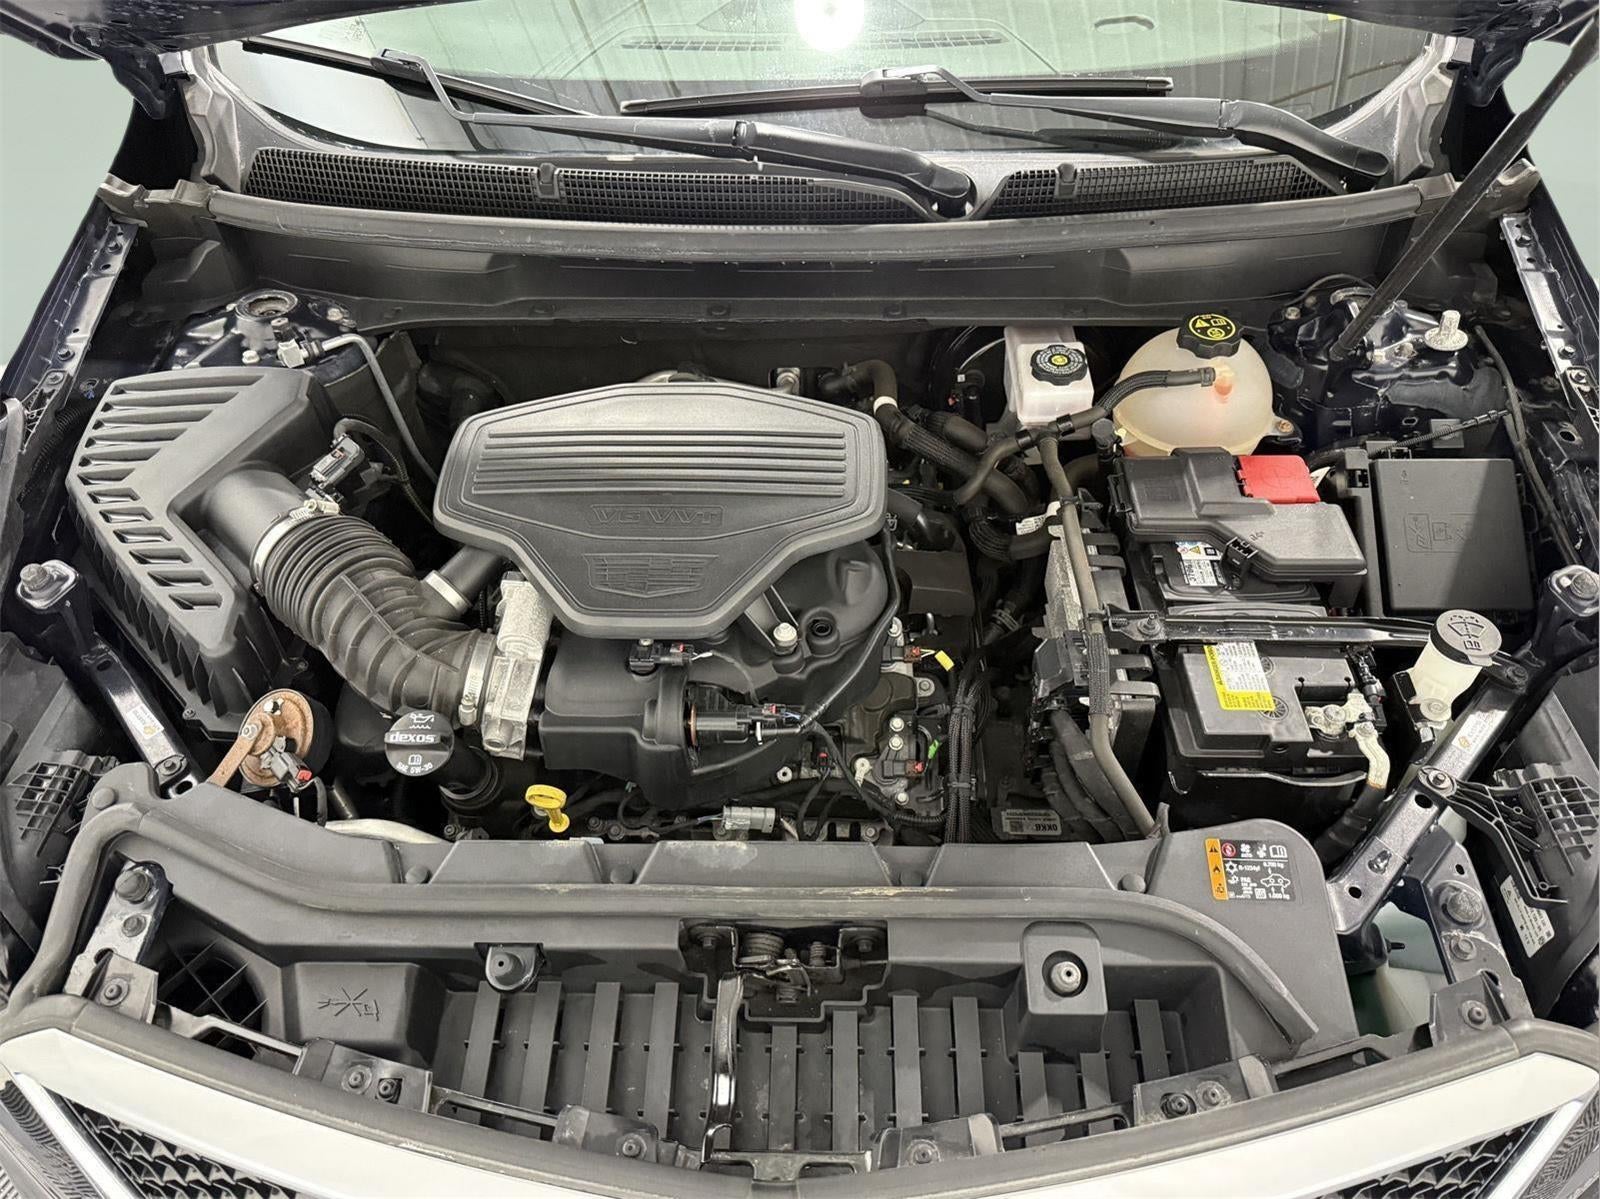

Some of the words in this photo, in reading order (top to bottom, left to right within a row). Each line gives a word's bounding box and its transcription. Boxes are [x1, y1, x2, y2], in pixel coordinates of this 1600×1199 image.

[592, 507, 640, 524] V6
[646, 507, 719, 524] VVT
[389, 731, 437, 743] dexos
